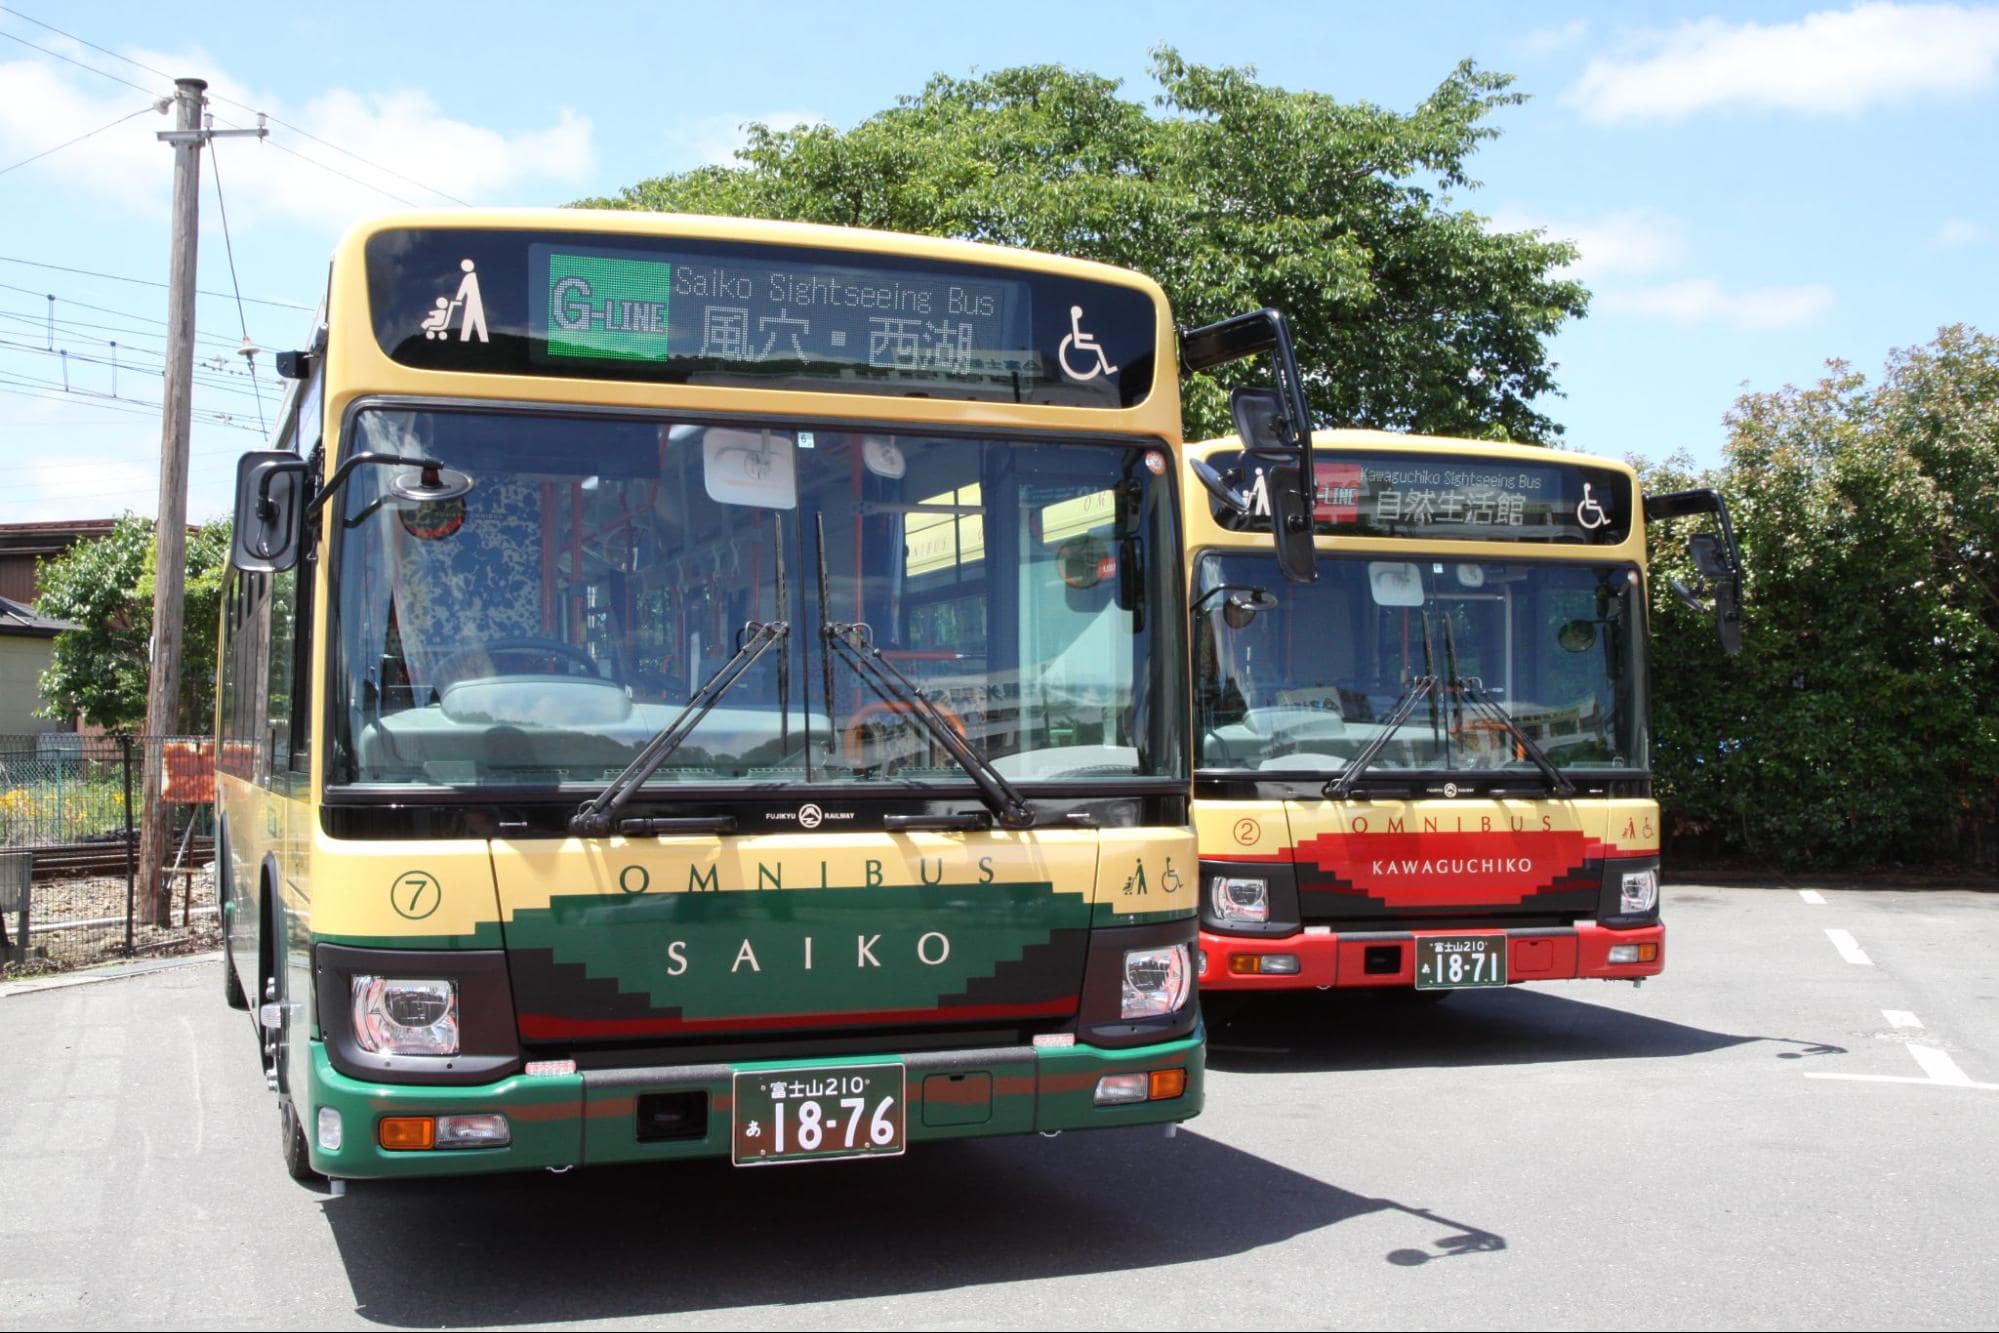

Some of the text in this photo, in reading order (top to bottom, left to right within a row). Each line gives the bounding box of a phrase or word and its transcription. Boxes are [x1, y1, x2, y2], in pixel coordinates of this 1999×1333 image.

[553, 276, 666, 332] G-LINE
[676, 266, 994, 316] Saiko Sightseeing Bus
[1313, 478, 1357, 507] -LINE
[1360, 467, 1542, 489] Kawaguchiko Sightseeing Bus
[1376, 488, 1527, 526] 自然生活館
[765, 812, 796, 820] FUJIKYU
[1351, 814, 1553, 834] OMNIBUS
[618, 856, 995, 894] OMNIBUS
[1372, 857, 1533, 876] KAWAGUCHIKO
[666, 931, 951, 976] SAIKO
[1437, 952, 1497, 983] 18-71
[745, 1096, 895, 1153] あ 18-76
